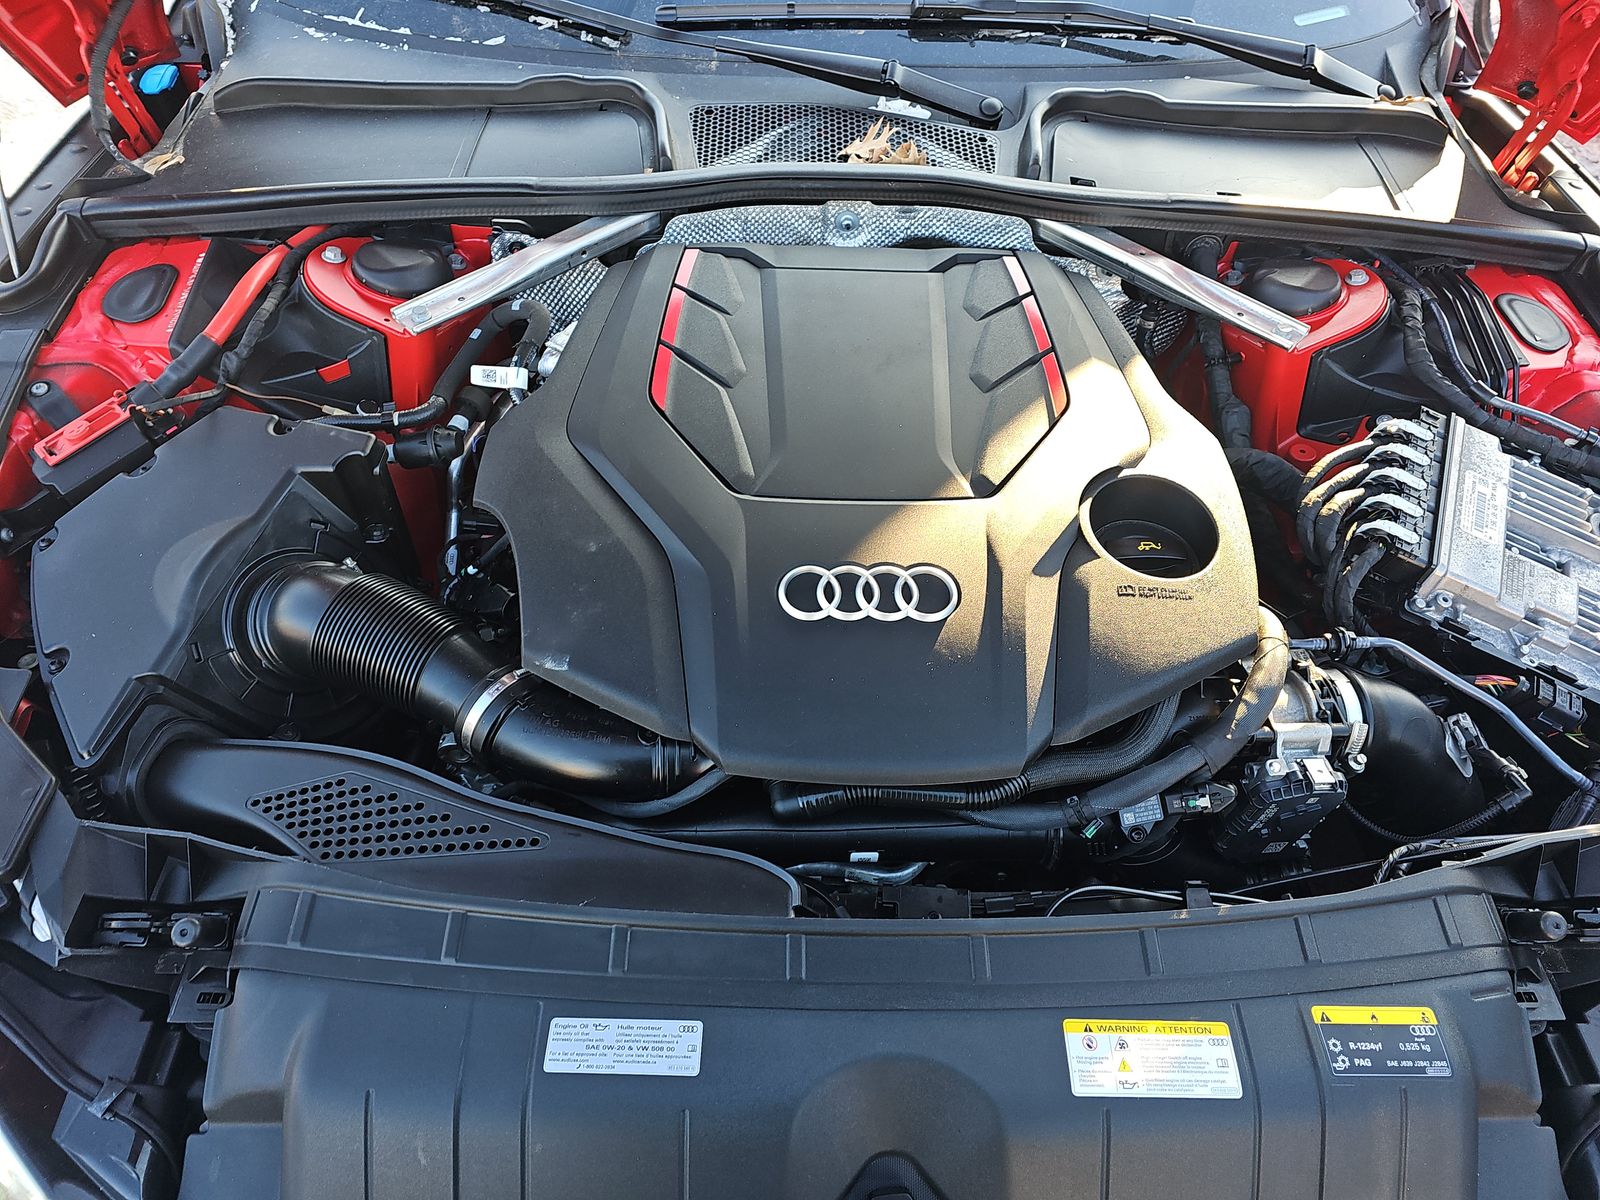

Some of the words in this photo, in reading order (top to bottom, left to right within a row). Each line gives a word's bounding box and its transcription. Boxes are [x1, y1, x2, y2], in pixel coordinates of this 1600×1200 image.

[554, 1022, 578, 1030] Engine
[1096, 1025, 1149, 1034] WARNING
[1154, 1026, 1212, 1035] ATTENTION
[1348, 1042, 1383, 1052] R-1234yf
[1399, 1042, 1420, 1052] 0,525
[1421, 1042, 1431, 1052] kg
[1354, 1058, 1372, 1067] PAG
